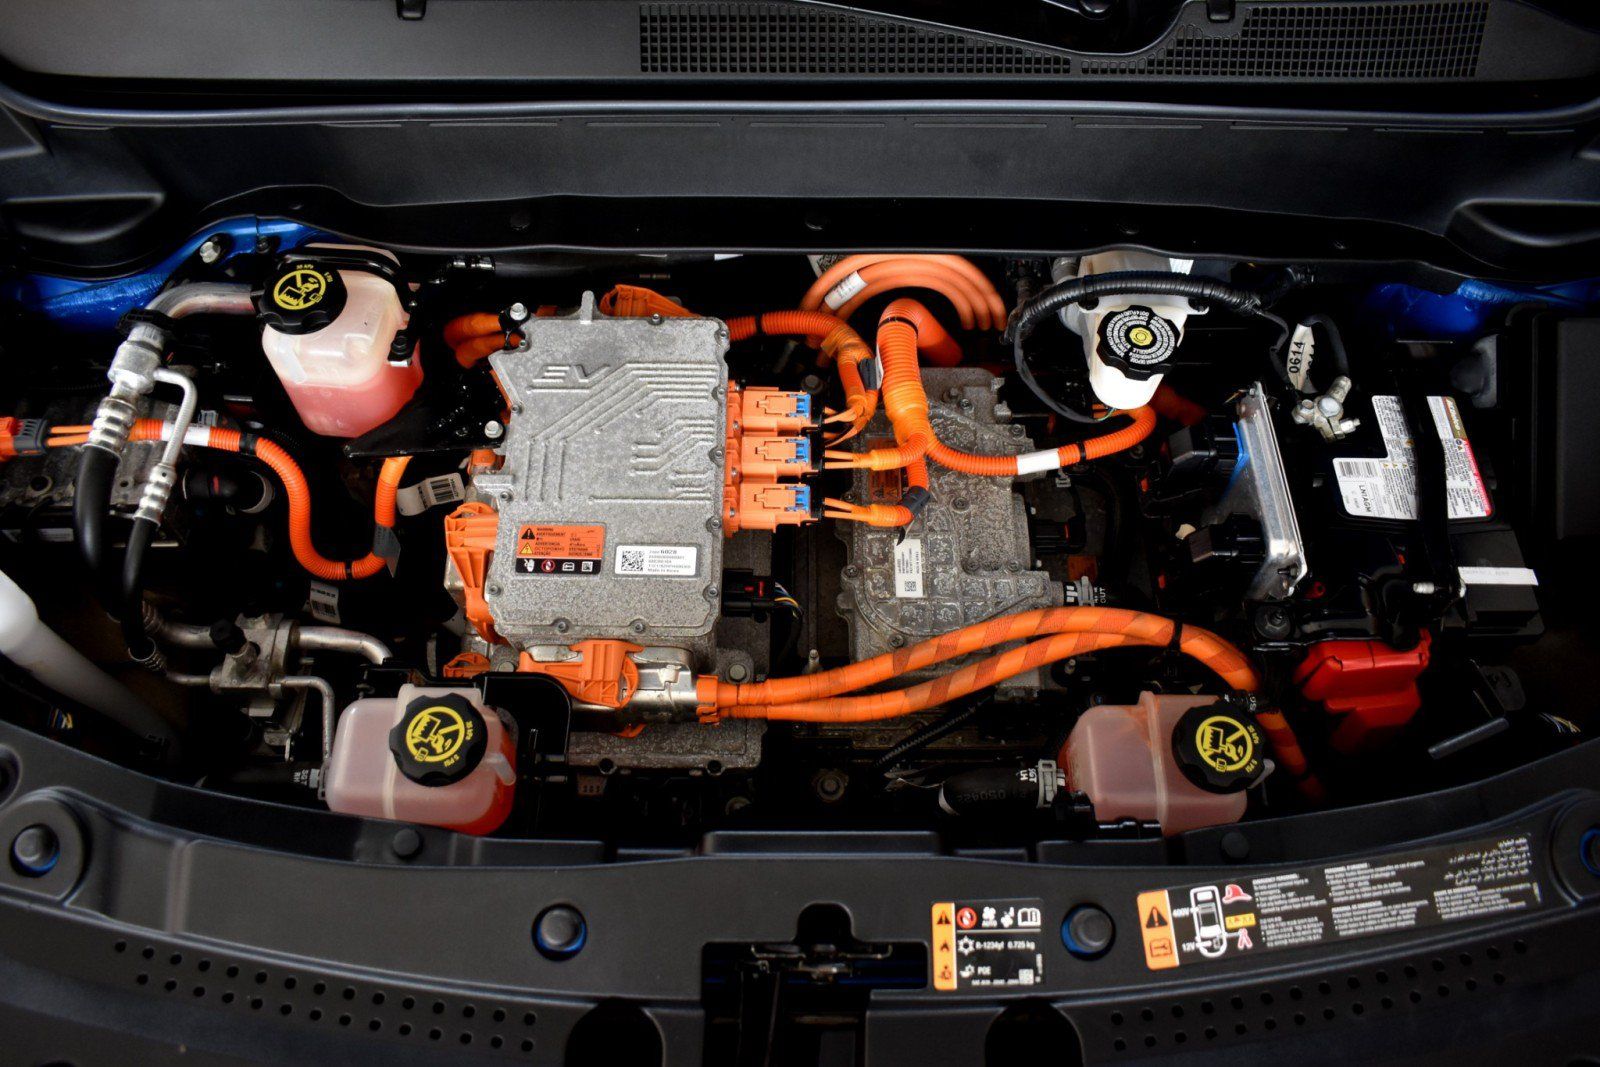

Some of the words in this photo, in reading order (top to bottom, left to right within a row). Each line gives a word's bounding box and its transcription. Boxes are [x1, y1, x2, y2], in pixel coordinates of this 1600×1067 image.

[1289, 341, 1304, 374] 0614
[530, 363, 610, 383] EV
[466, 720, 473, 729] 35
[444, 758, 455, 767] PSI
[1019, 770, 1028, 781] LH
[1028, 768, 1037, 783] SGT
[975, 941, 1004, 950] R-1234yf
[1026, 941, 1035, 950] kg
[1182, 942, 1195, 952] 12V
[977, 966, 991, 975] POE
